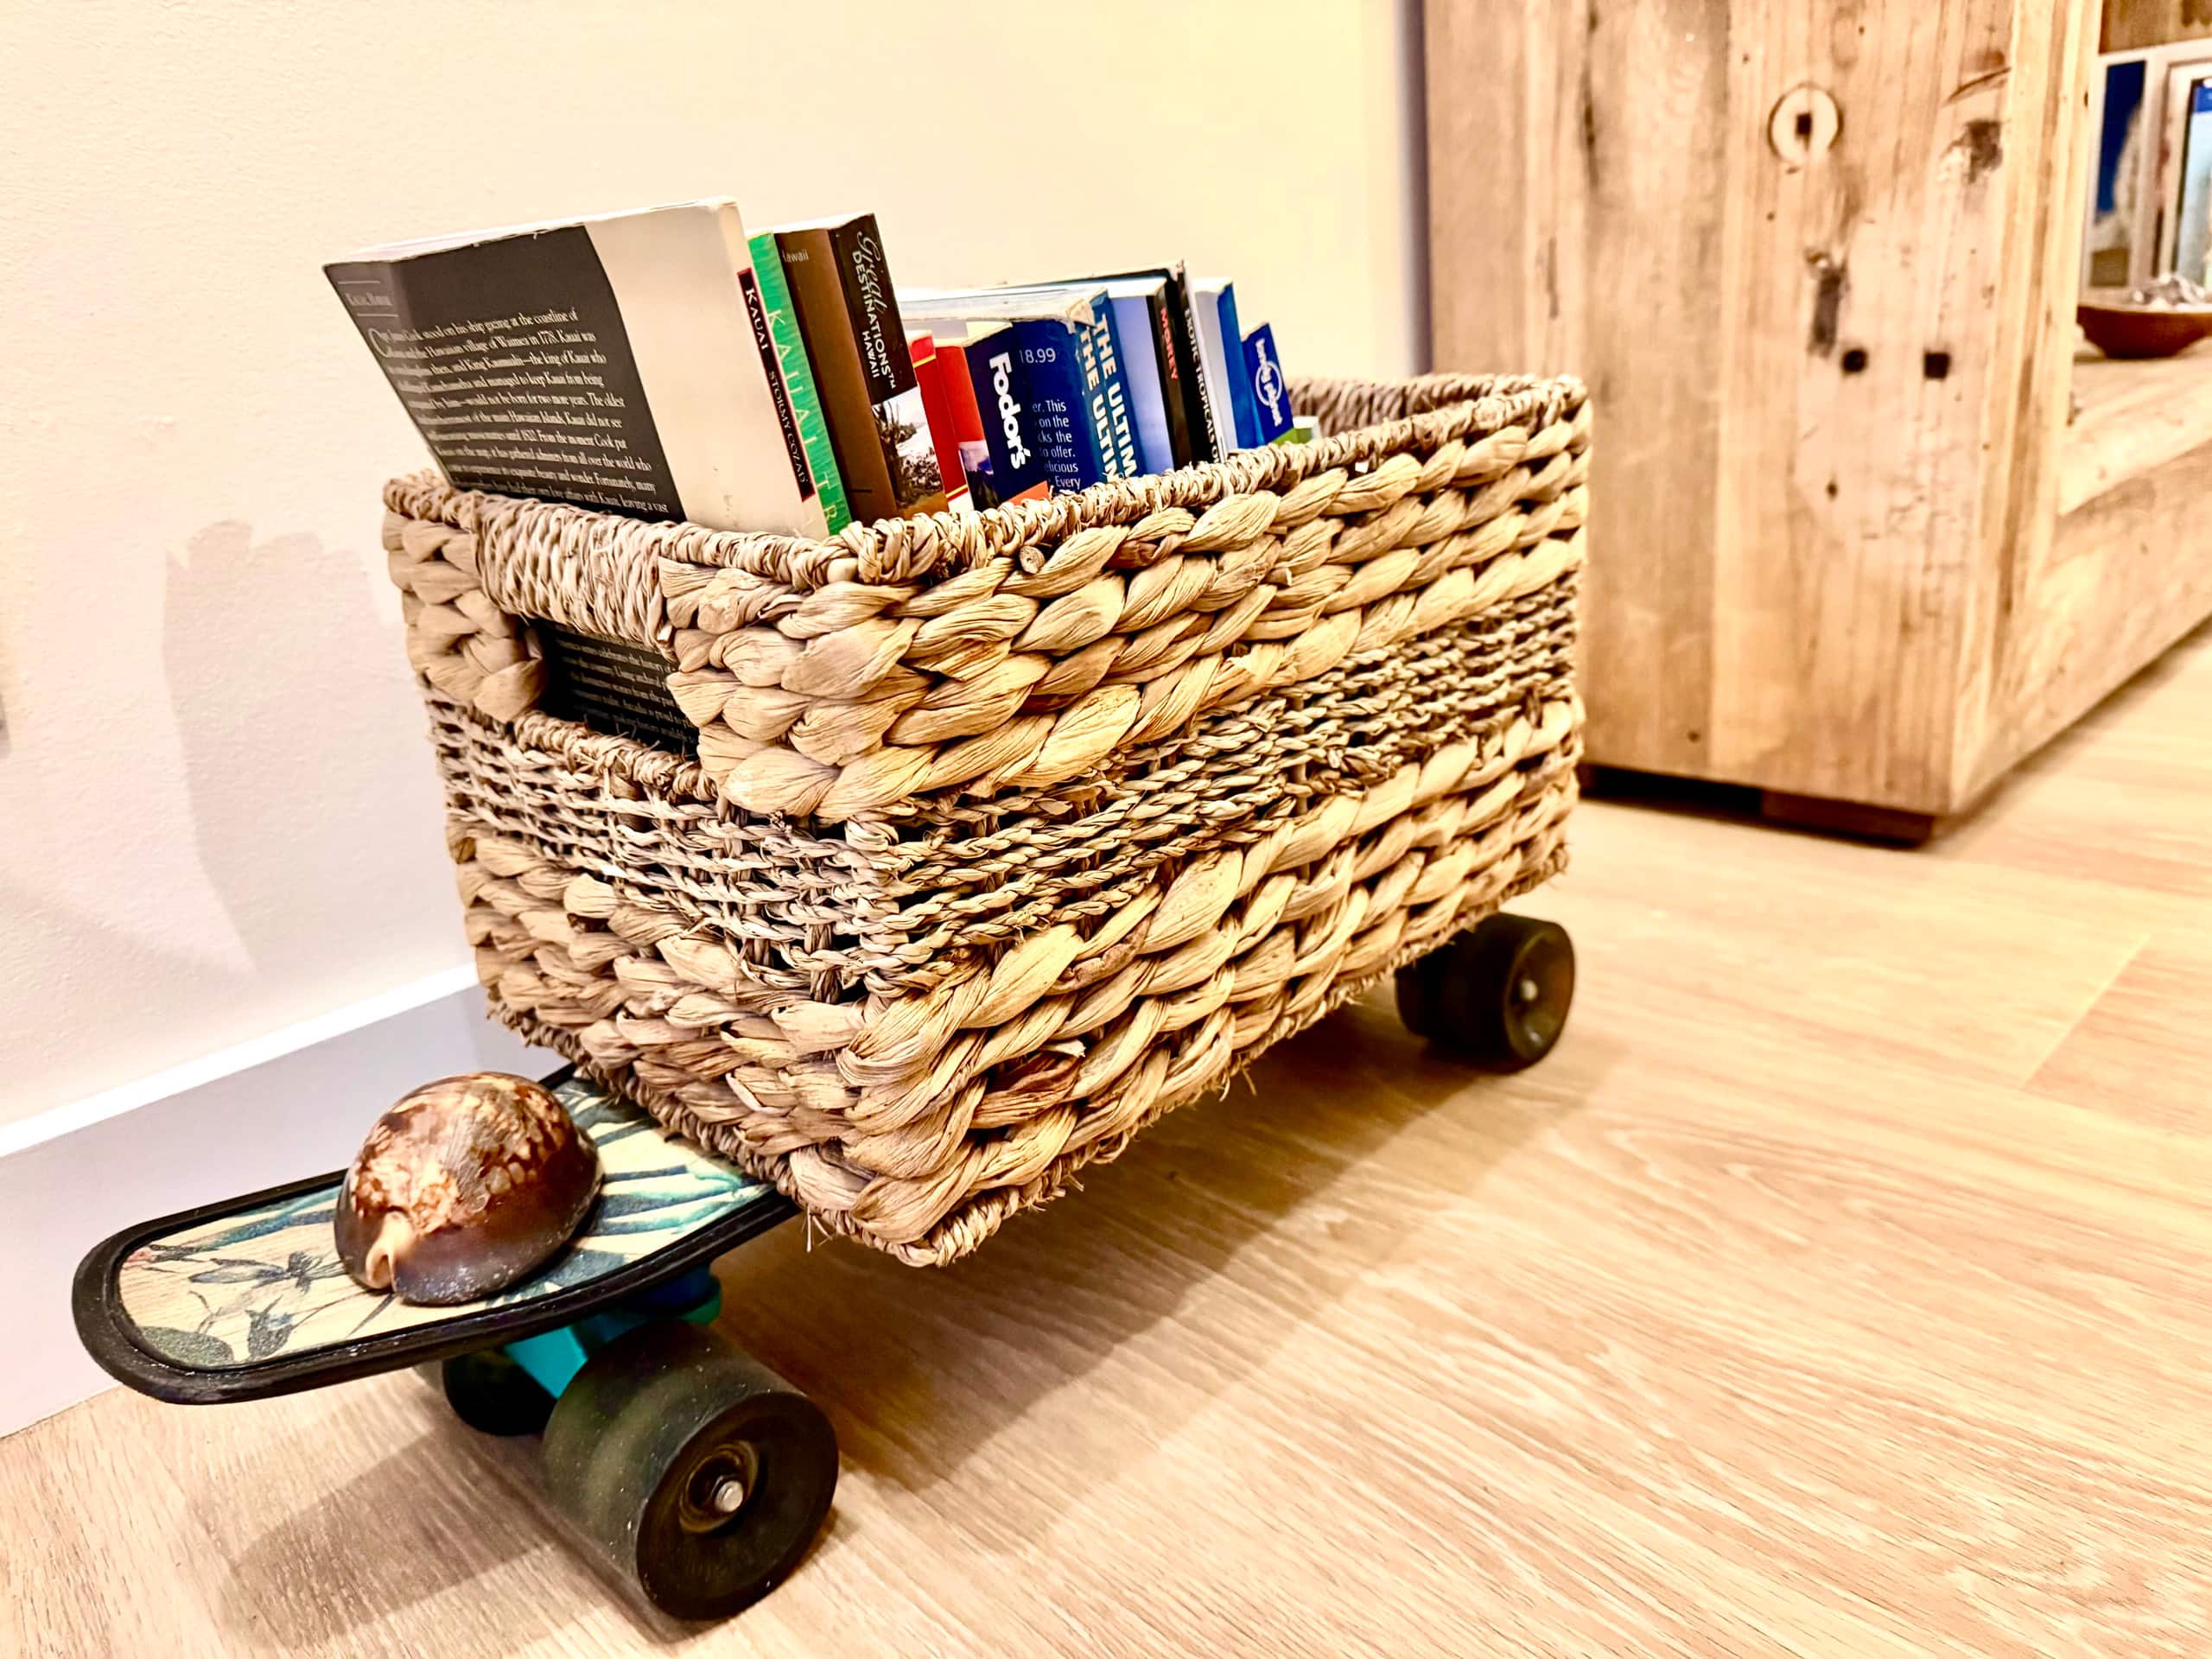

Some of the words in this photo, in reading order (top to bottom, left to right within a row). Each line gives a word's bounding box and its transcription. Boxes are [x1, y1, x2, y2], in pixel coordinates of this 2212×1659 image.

[857, 231, 887, 315] Great
[485, 319, 512, 333] gazing
[510, 317, 519, 327] at
[518, 312, 534, 326] the
[533, 308, 569, 324] coastline
[569, 307, 579, 321] of
[746, 288, 768, 350] KAUAI
[528, 334, 539, 345] in
[540, 351, 562, 366] king
[862, 331, 880, 378] HAWAII
[587, 391, 606, 407] The
[605, 392, 626, 408] oldest
[768, 371, 791, 429] STORMY
[1080, 326, 1100, 391] THE
[1092, 393, 1121, 482] ULTIM
[1093, 313, 1117, 379] THE
[1107, 381, 1138, 478] ULTIM
[1195, 365, 1216, 443] TROPICALS
[1046, 398, 1067, 413] This
[1053, 416, 1070, 428] the
[594, 434, 615, 448] Cook
[614, 438, 627, 452] put
[1038, 432, 1052, 443] cks
[1056, 431, 1073, 443] the
[1051, 446, 1076, 458] offer.
[602, 454, 616, 467] the
[615, 455, 635, 470] world
[635, 456, 652, 472] who
[1044, 461, 1079, 474] elicious
[1055, 475, 1081, 489] Every
[619, 493, 647, 512] leaving
[653, 502, 670, 513] vast
[817, 471, 838, 521] TR
